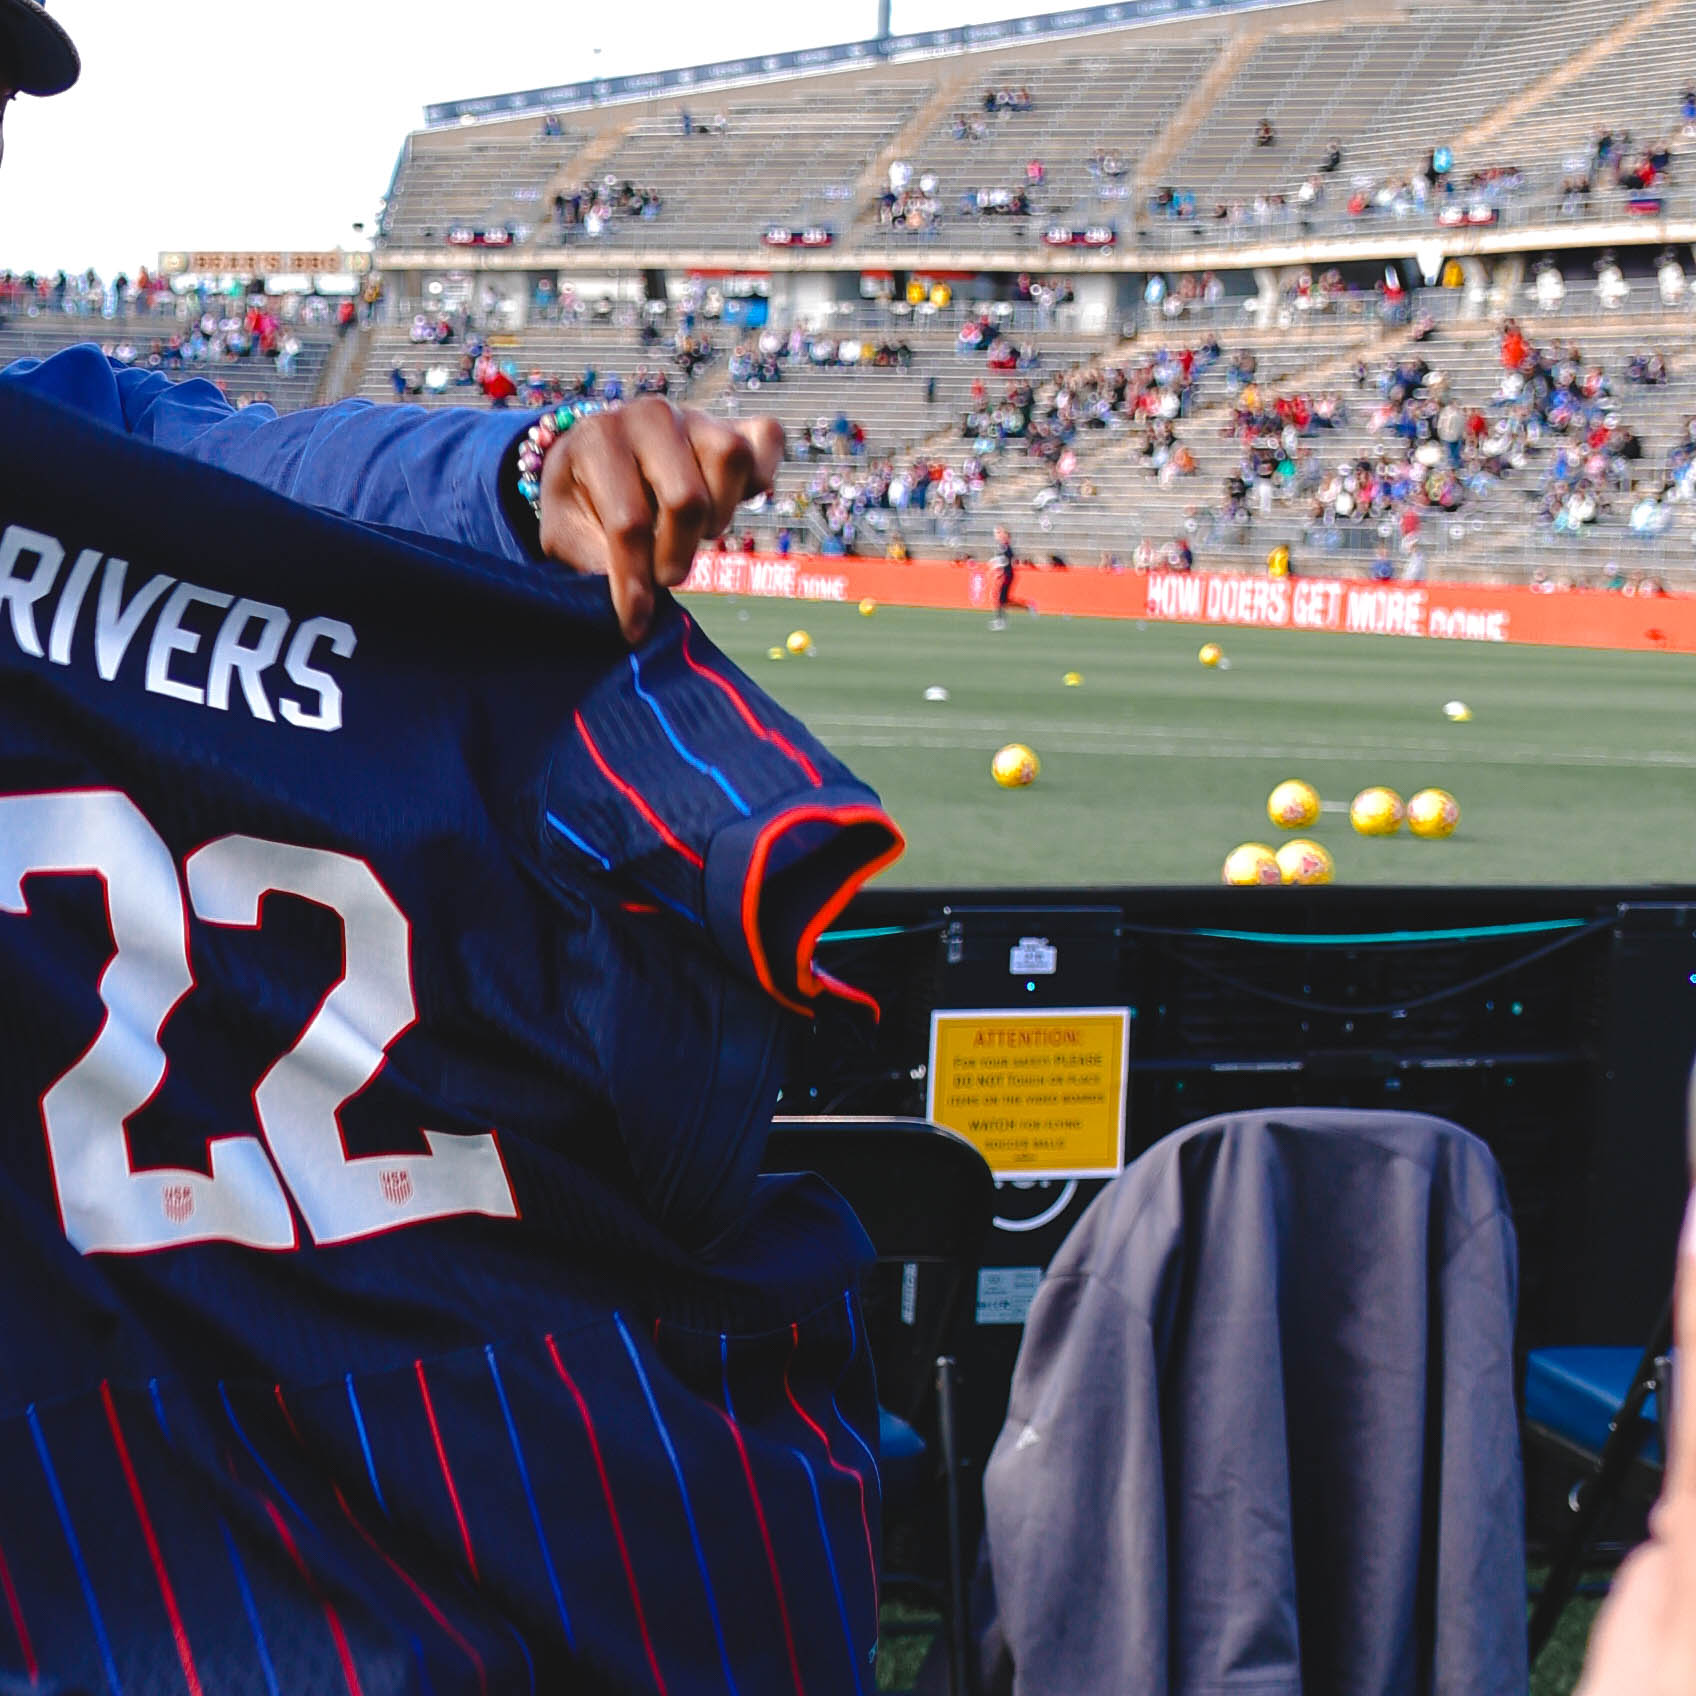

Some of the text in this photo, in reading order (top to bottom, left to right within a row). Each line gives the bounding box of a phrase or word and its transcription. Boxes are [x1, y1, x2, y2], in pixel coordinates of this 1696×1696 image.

[1147, 574, 1200, 617] HOW
[1206, 576, 1289, 625] DOERS
[1292, 580, 1343, 629] GET
[1346, 590, 1426, 637] MORE
